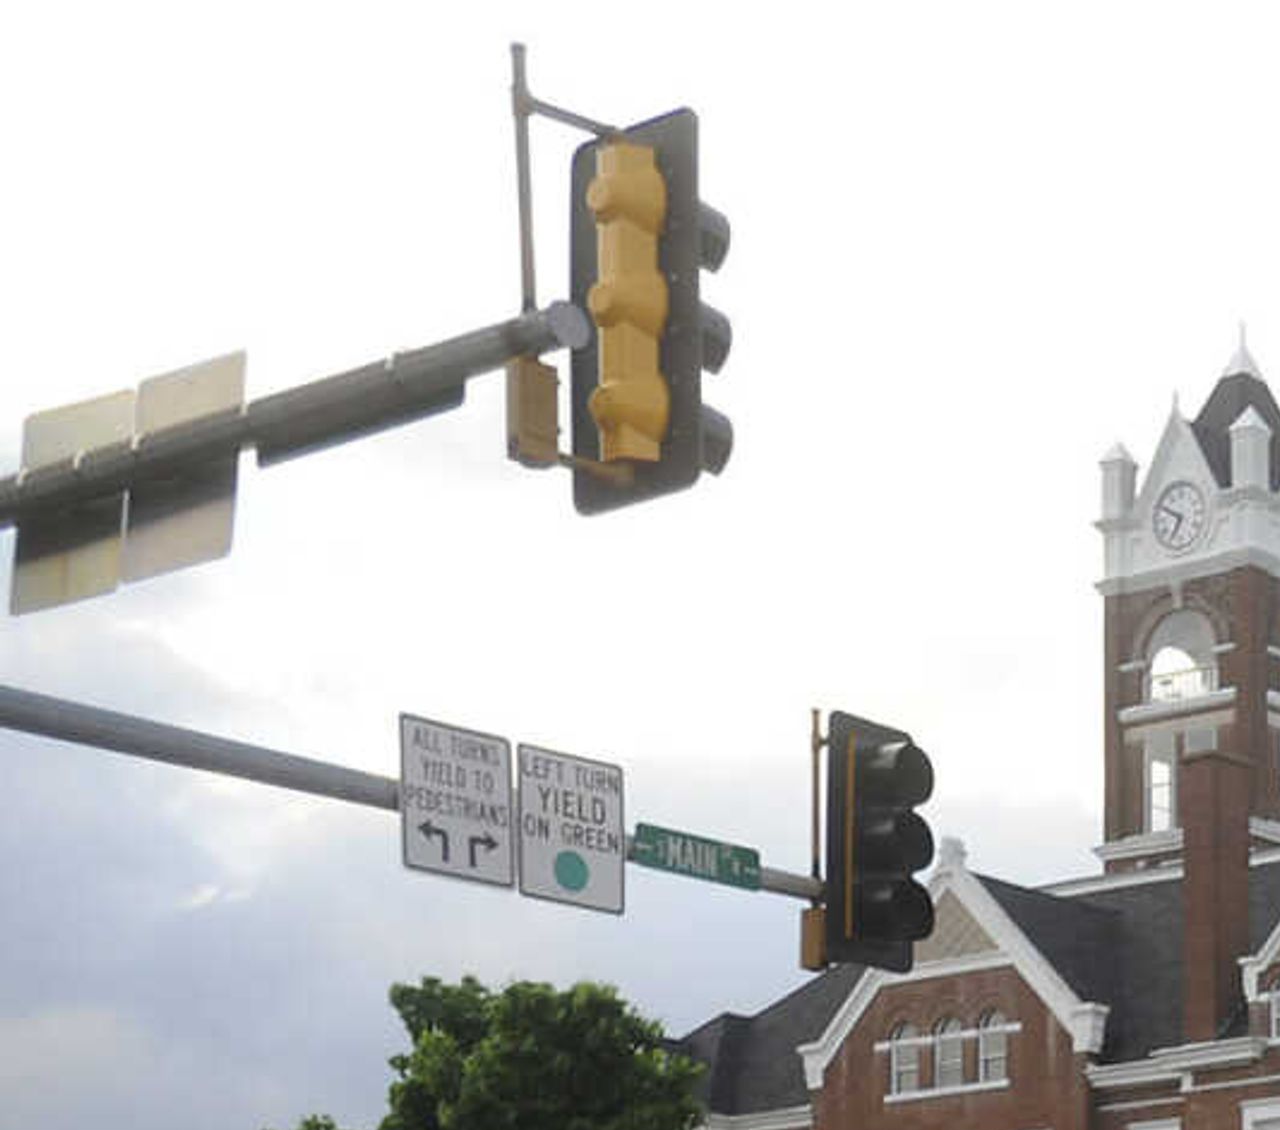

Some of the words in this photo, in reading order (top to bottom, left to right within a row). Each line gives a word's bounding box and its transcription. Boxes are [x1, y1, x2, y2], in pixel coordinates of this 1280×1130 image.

[412, 726, 443, 754] ALL
[421, 759, 467, 789] YIELD
[470, 769, 496, 795] TO
[520, 749, 565, 783] LEFT
[574, 766, 619, 796] TURN
[402, 784, 508, 827] PEDESTRIANS
[537, 783, 607, 826] YIELD
[522, 812, 550, 844] ON
[560, 822, 619, 855] GREEN
[667, 835, 719, 878] MAIN
